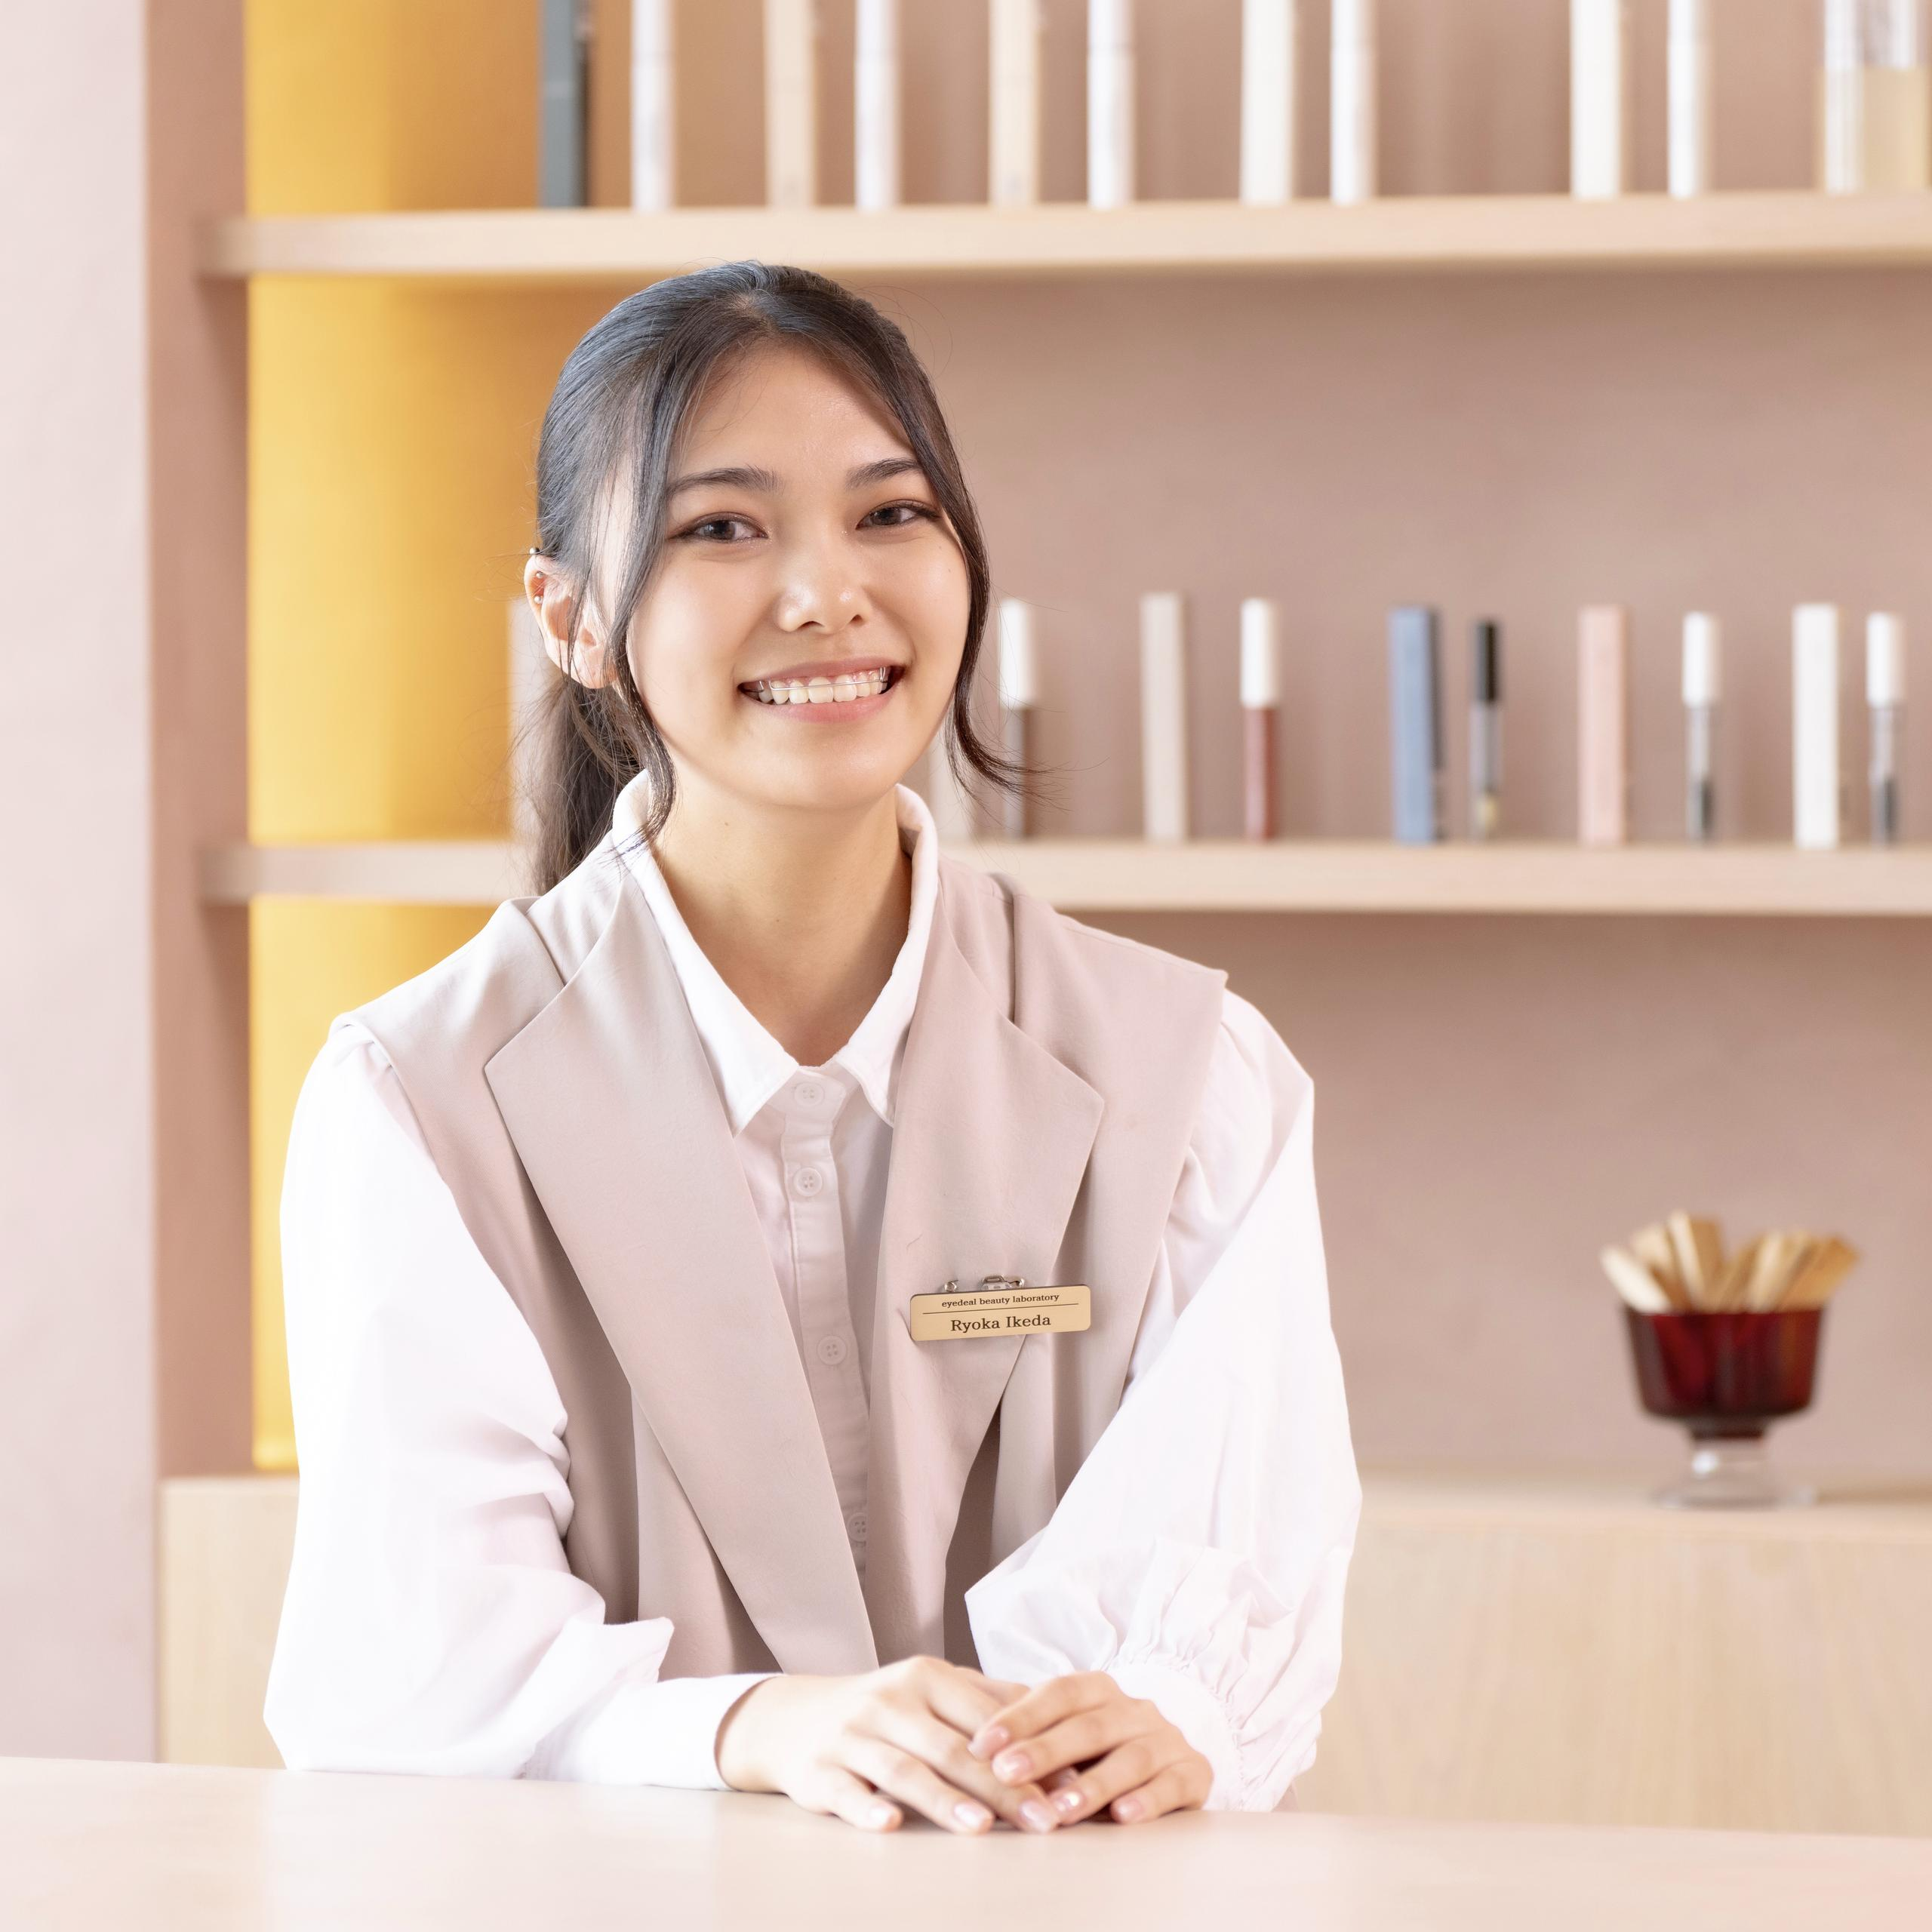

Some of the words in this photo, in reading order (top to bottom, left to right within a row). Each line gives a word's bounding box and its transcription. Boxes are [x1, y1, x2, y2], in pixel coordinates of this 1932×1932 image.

[941, 1298, 977, 1308] eyedeal
[980, 1297, 1010, 1305] beauty
[1012, 1294, 1060, 1303] laboratory
[950, 1318, 1001, 1333] Ryoka
[1005, 1315, 1051, 1328] Ikeda
